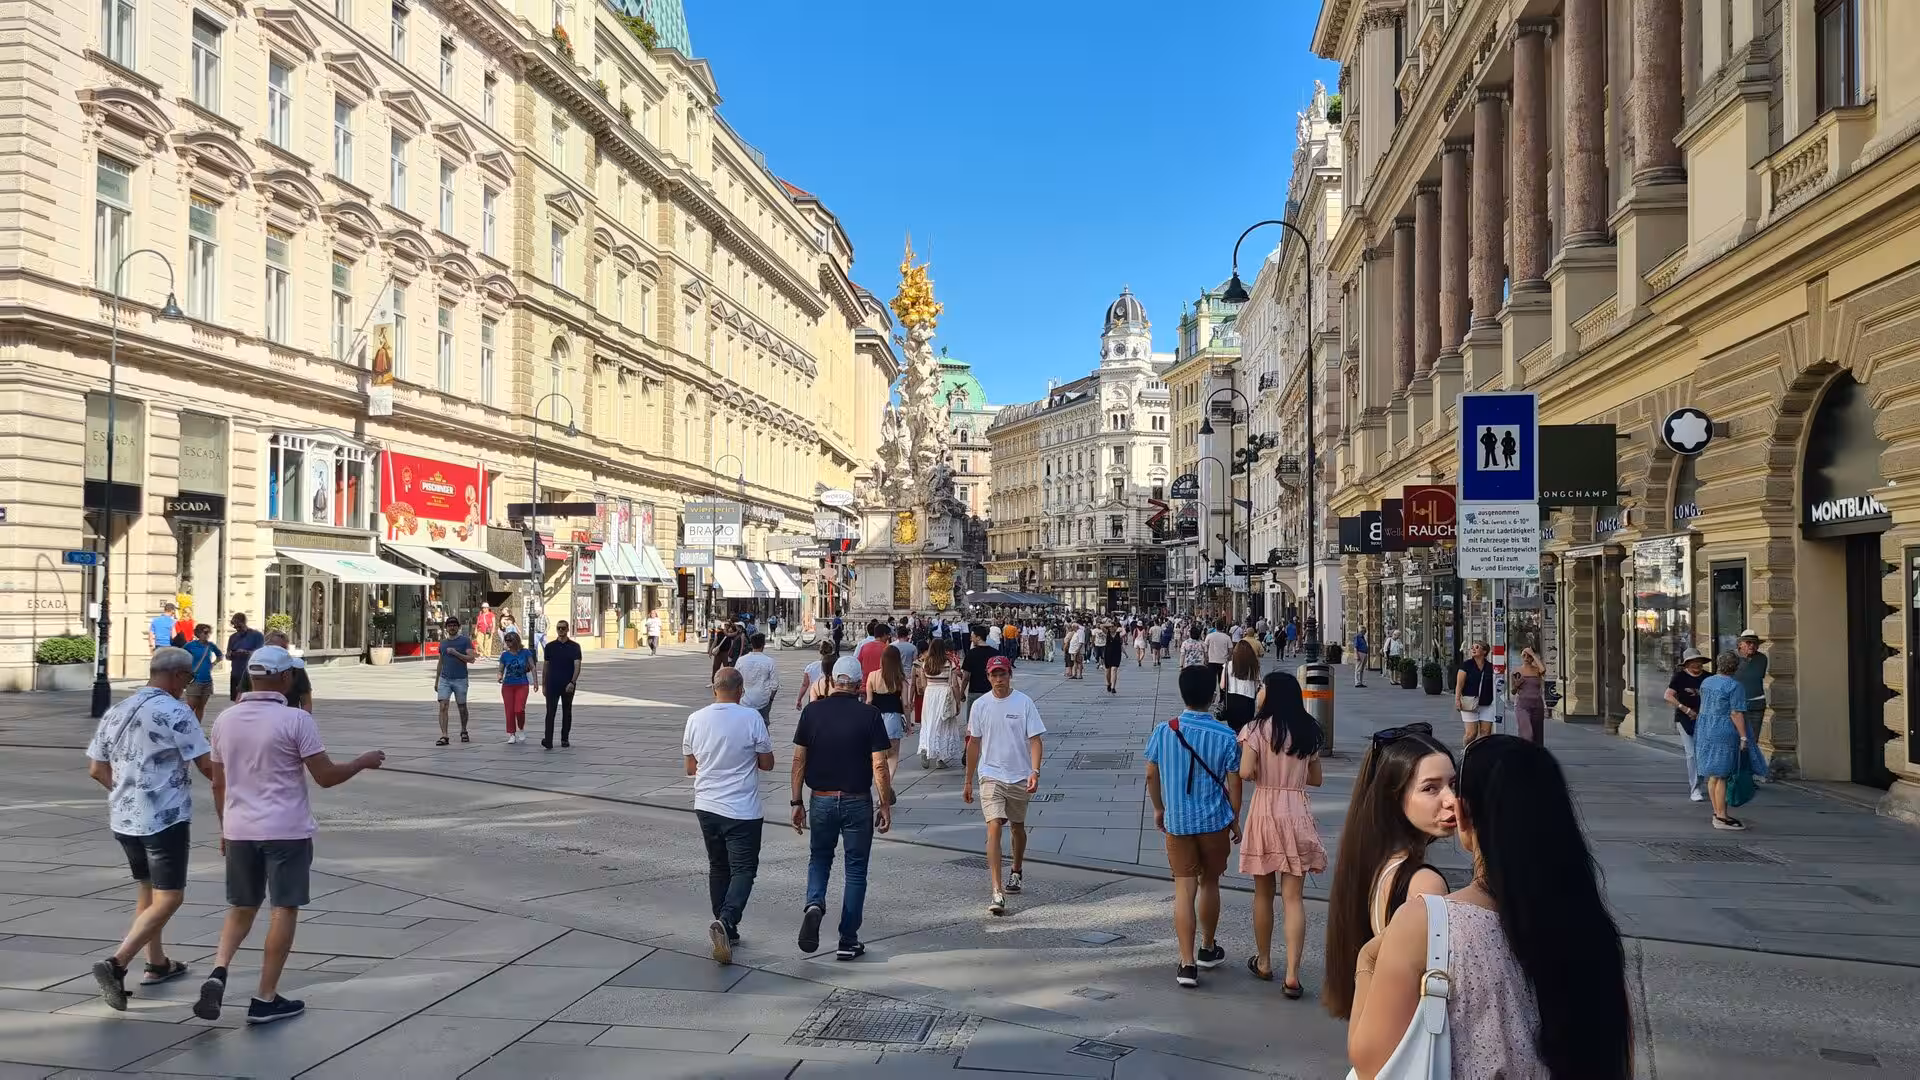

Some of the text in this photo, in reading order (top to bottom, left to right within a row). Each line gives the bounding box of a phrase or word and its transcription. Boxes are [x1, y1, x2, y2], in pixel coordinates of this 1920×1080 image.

[93, 430, 135, 447] ESADA
[166, 501, 211, 512] ESCADA
[1408, 525, 1457, 536] RAUCH
[1497, 527, 1535, 535] Ladetätigkeit
[28, 600, 68, 609] ESCADA
